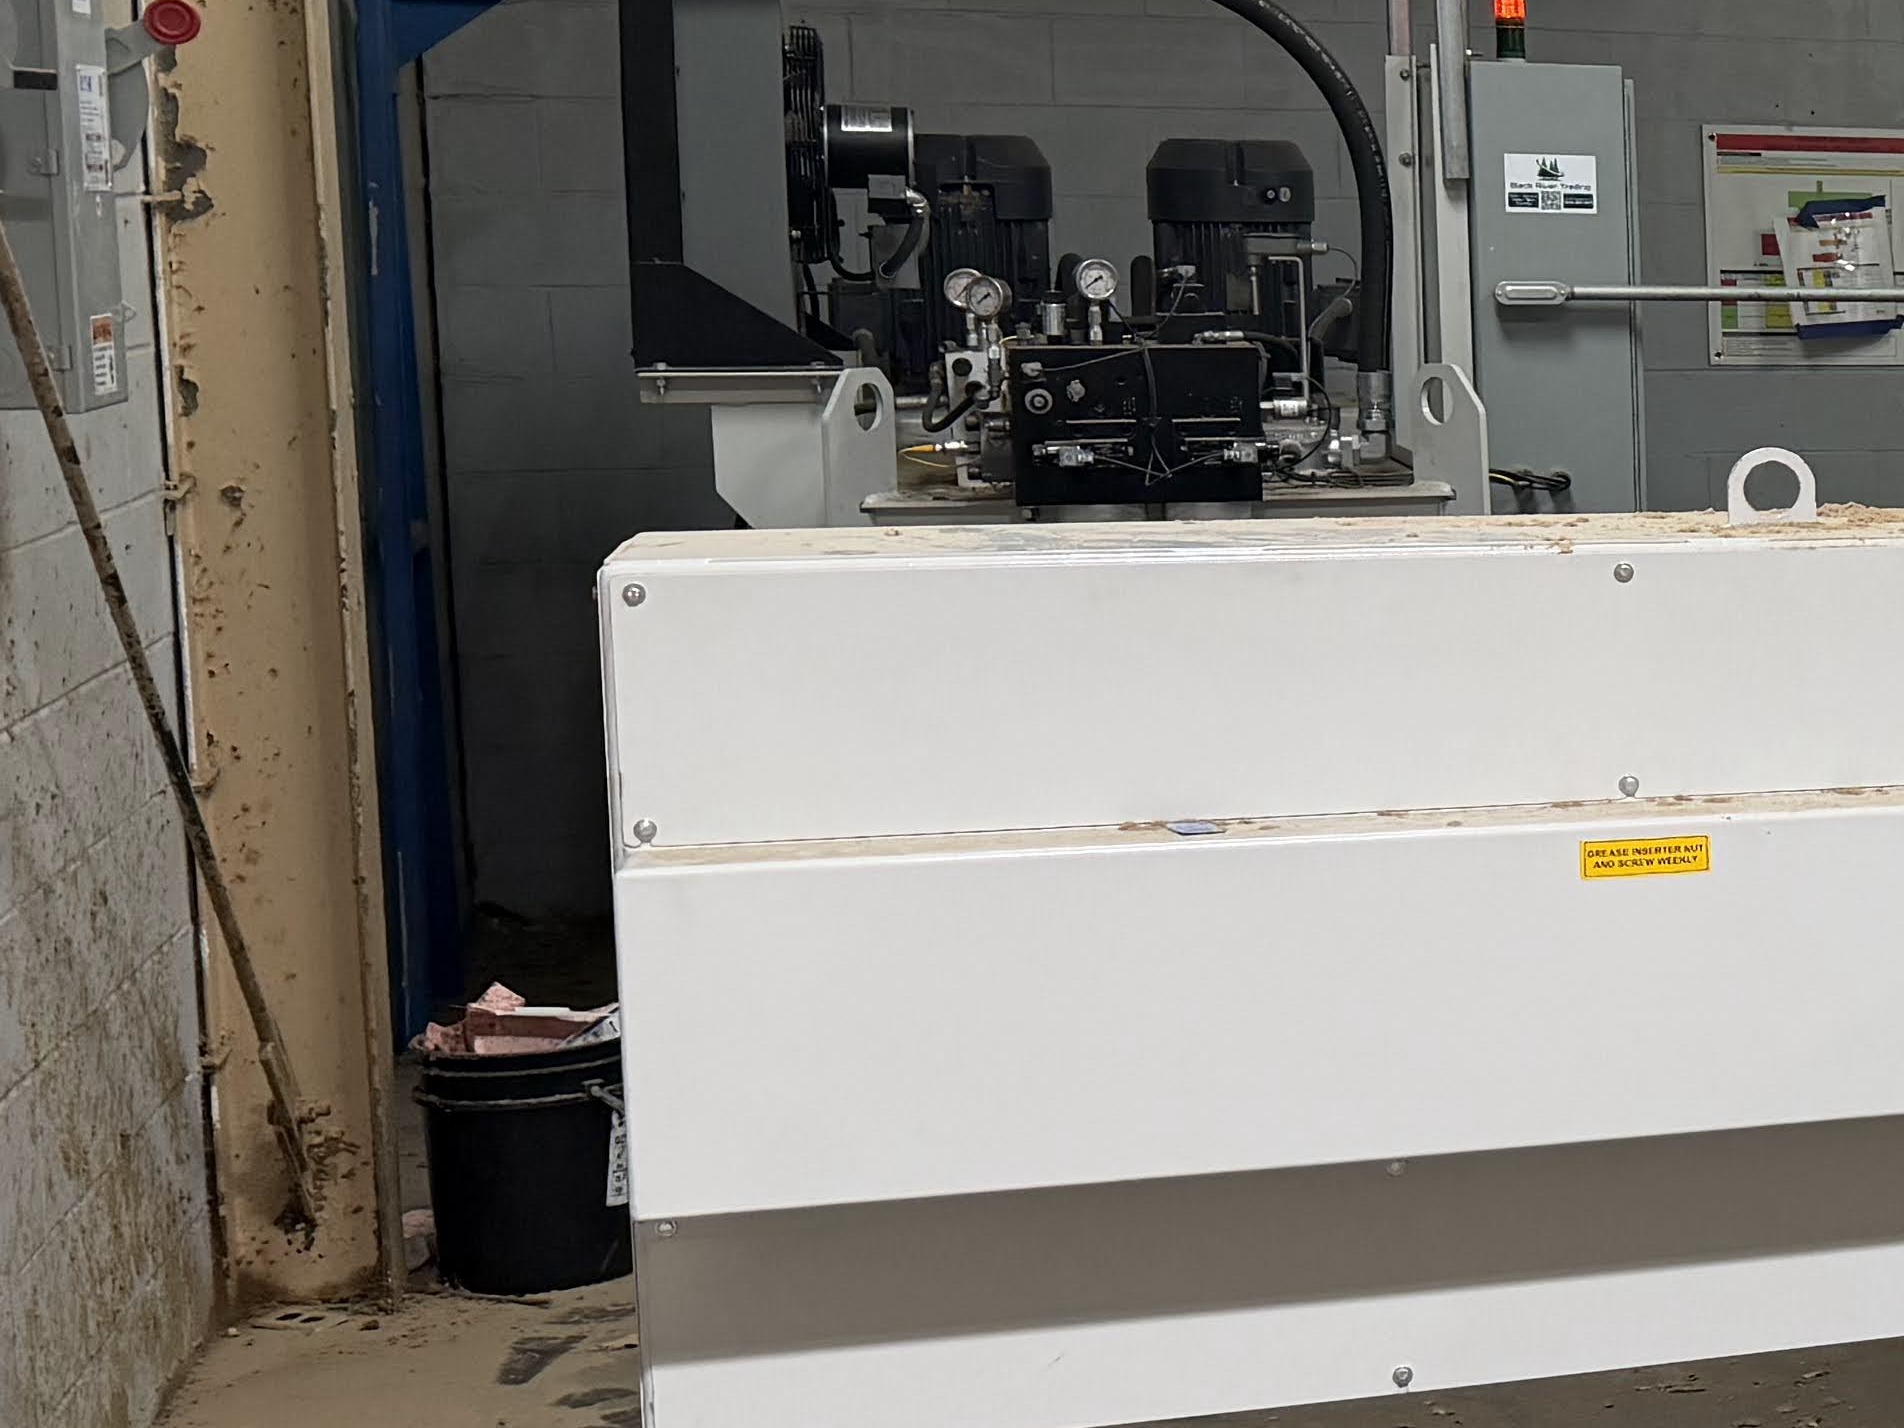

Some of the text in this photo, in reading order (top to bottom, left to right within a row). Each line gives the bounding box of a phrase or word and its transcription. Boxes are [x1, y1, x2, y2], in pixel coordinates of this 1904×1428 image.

[1587, 844, 1703, 858] GREASE INSERTER NUT
[1593, 855, 1698, 869] AND SCREW WEEKLY
